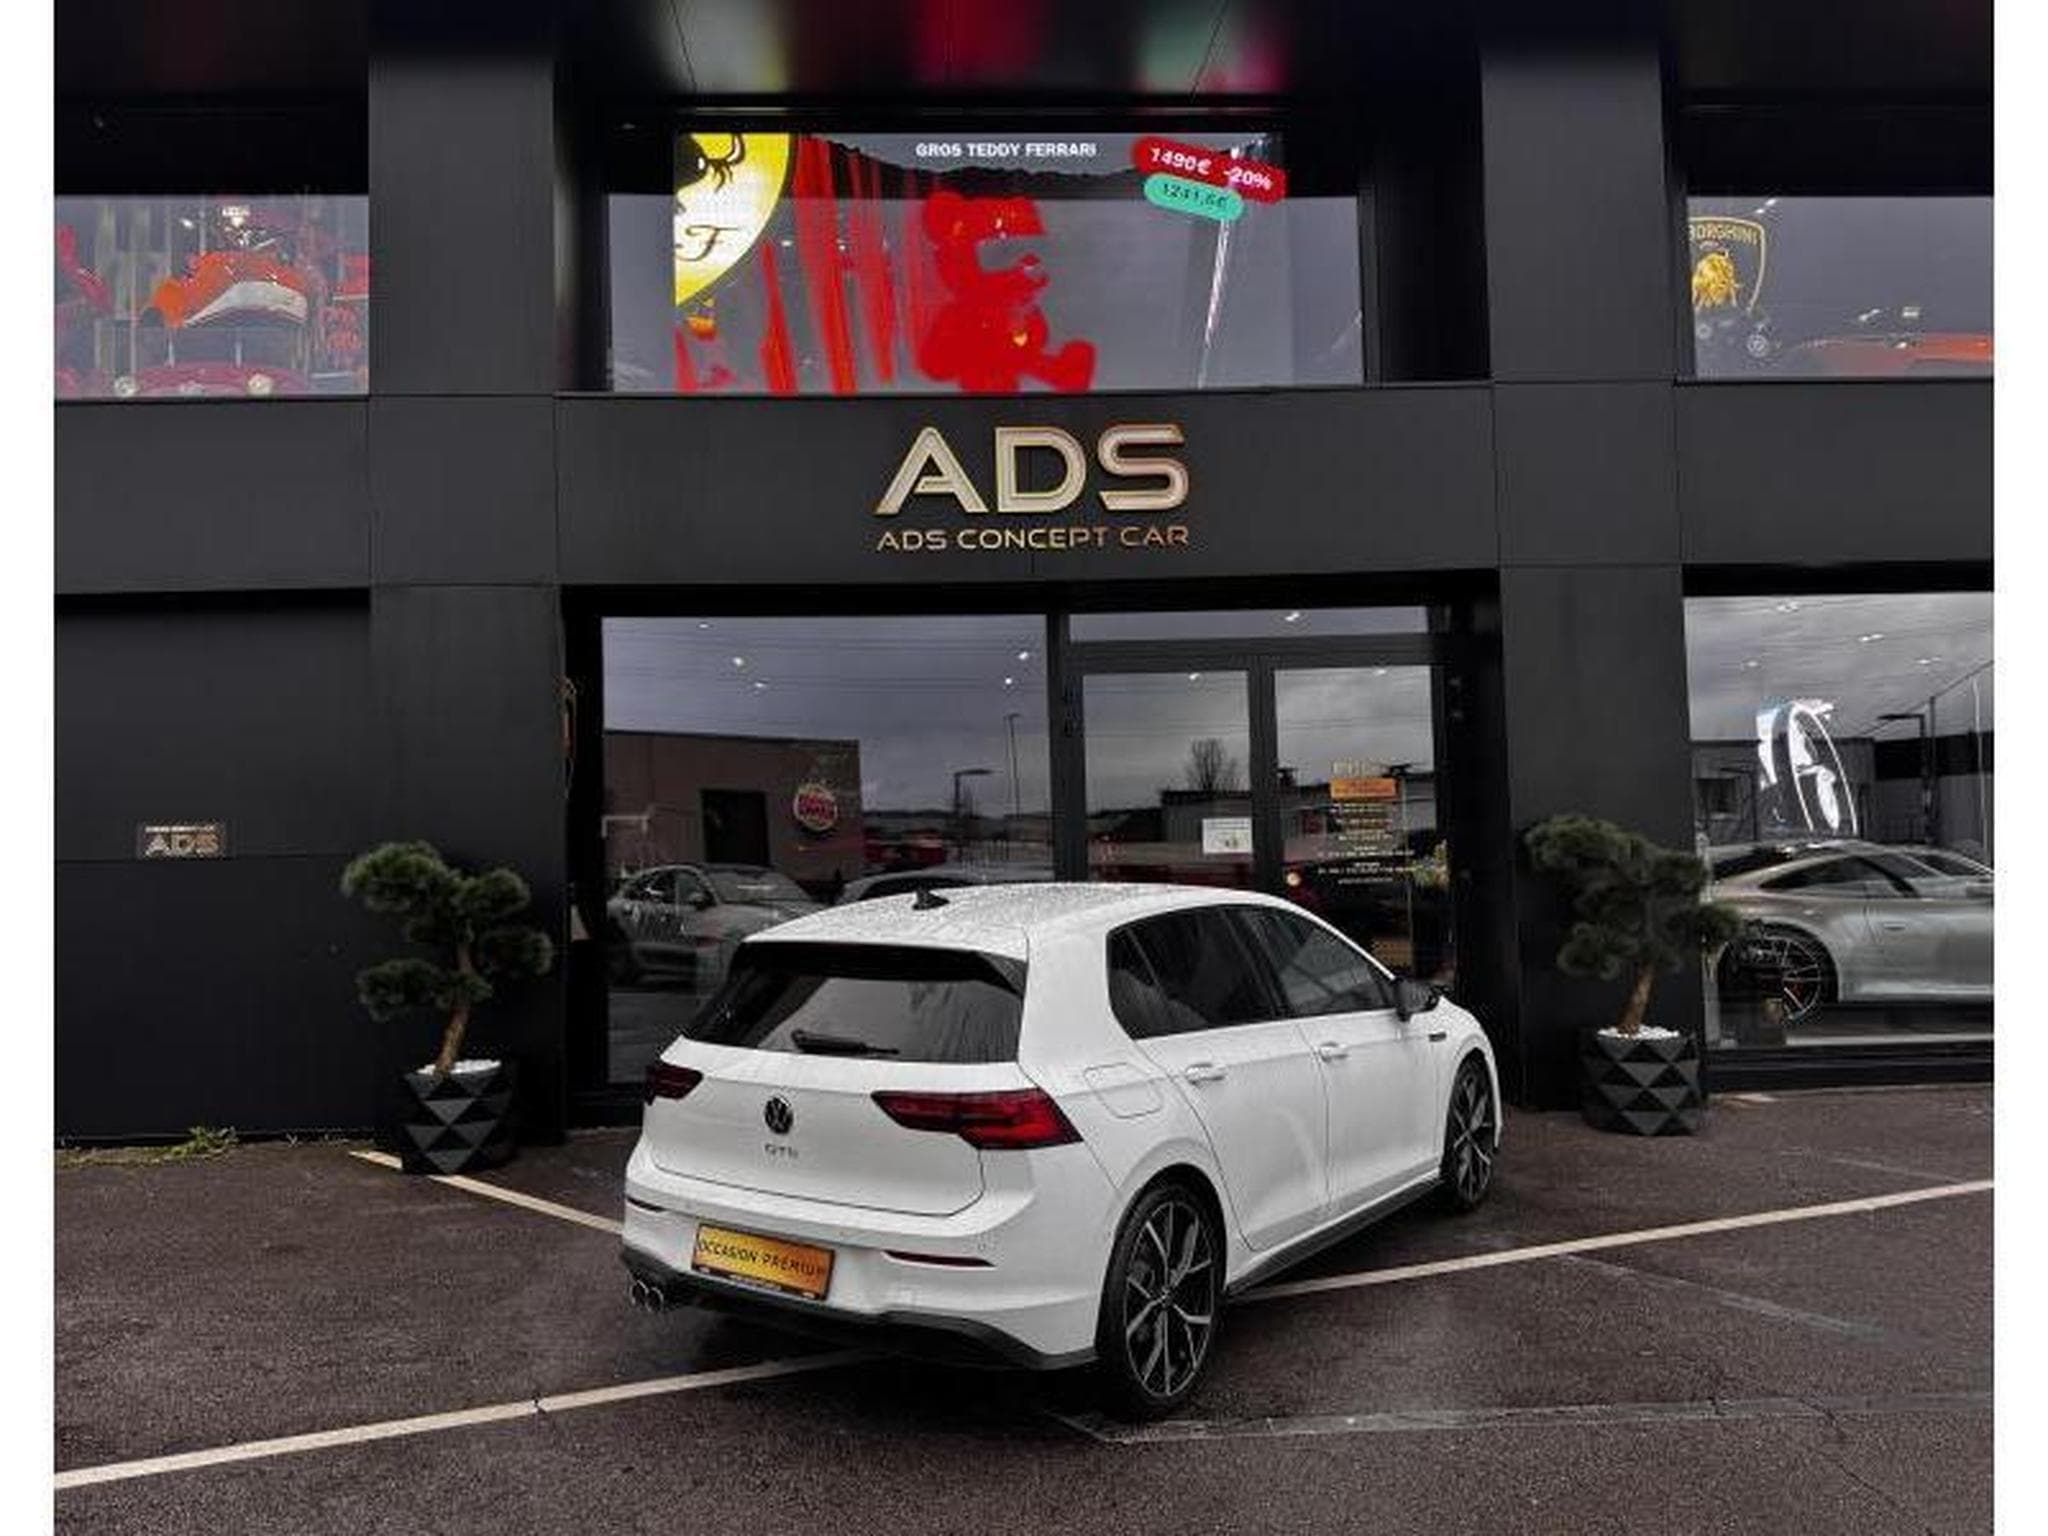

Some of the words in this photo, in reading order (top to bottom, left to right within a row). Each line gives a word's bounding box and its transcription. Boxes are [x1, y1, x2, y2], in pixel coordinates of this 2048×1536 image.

[916, 143, 962, 157] GROS
[967, 143, 1020, 157] TEDDY
[1025, 143, 1097, 157] FERRARI
[1224, 166, 1272, 190] -20%
[875, 425, 1189, 514] ADS
[877, 530, 948, 550] ADS
[957, 527, 1109, 549] CONCEPT
[1120, 526, 1189, 546] CAR
[698, 1239, 758, 1264] OCCASION
